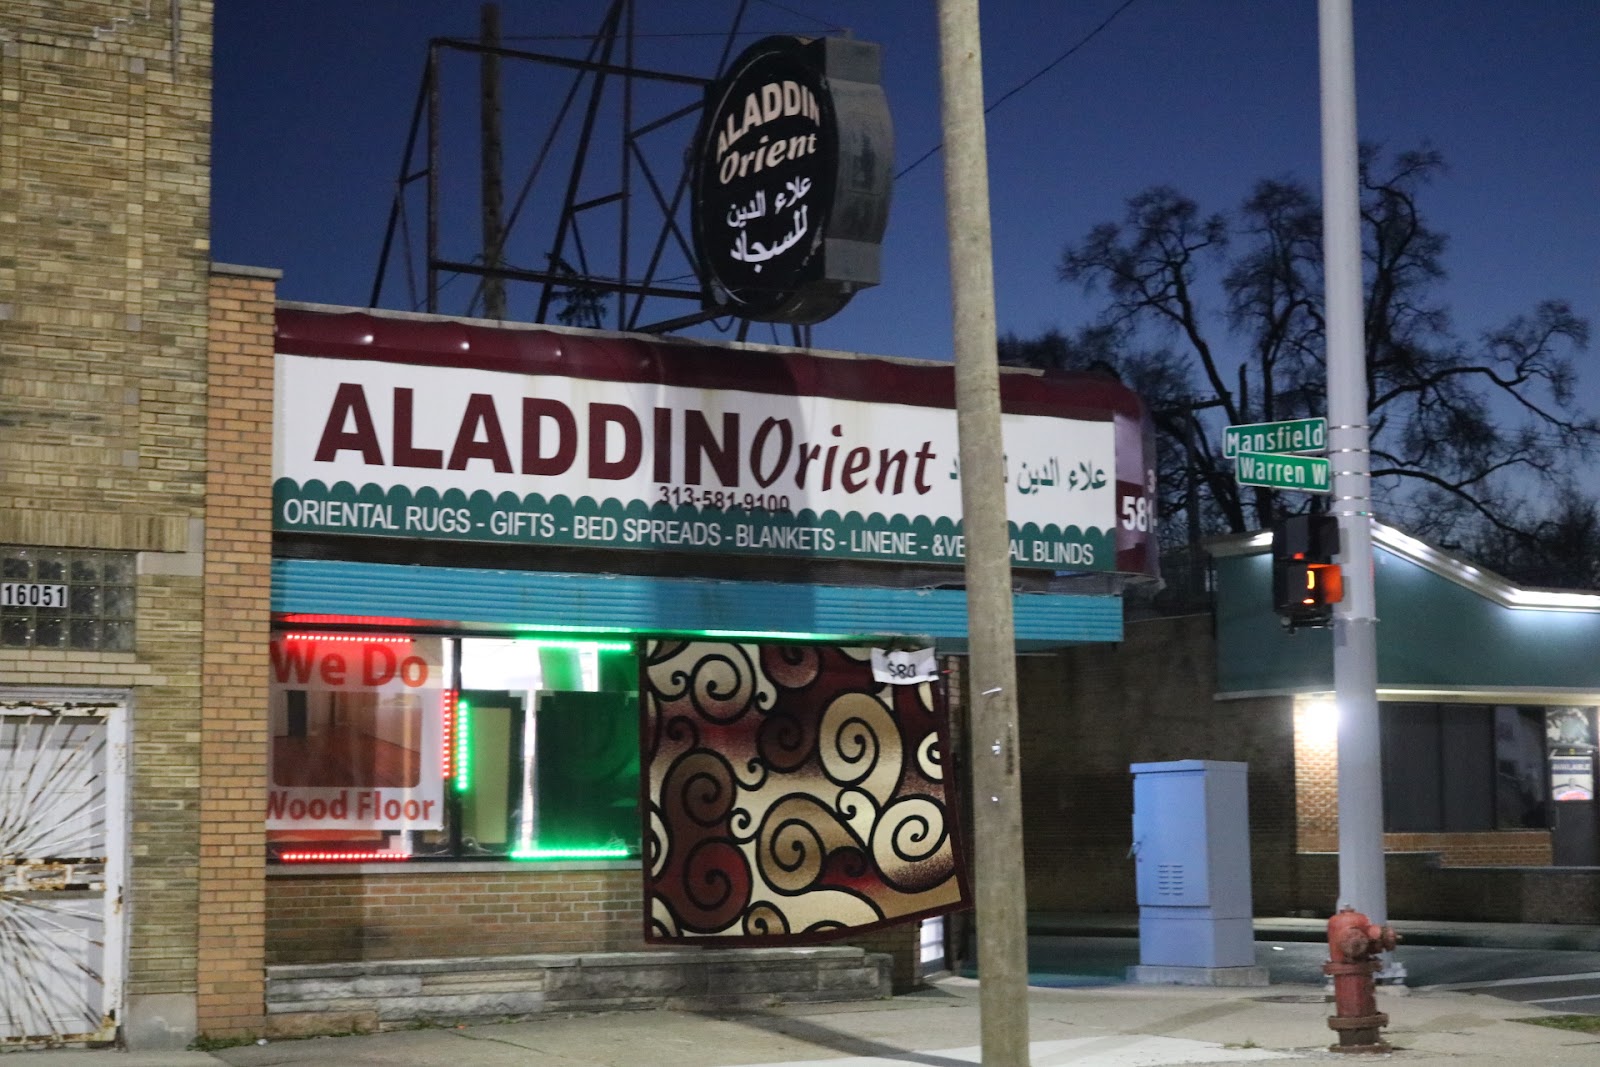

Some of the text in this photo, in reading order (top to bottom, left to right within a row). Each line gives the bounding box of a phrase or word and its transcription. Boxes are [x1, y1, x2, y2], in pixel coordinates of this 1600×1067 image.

[716, 79, 821, 164] ALADDIN
[719, 133, 818, 185] Orient
[726, 176, 812, 228] علاء الدين
[314, 381, 936, 496] ALADDIN Orient
[1226, 423, 1325, 454] Mansfield
[1016, 456, 1061, 495] الدين
[1068, 460, 1107, 491] علاء
[1239, 456, 1327, 486] Warren W
[659, 485, 790, 513] 313-581-9100
[283, 498, 400, 530] ORIENTAL
[405, 505, 471, 534] RUGS
[489, 510, 556, 538] GIFTS
[573, 515, 618, 542] BED
[622, 518, 722, 547] SPREADS
[735, 523, 836, 551] BLANKETS
[850, 530, 917, 556] LINENE
[1032, 540, 1094, 566] BLINDS
[5, 584, 64, 607] 16051
[270, 640, 429, 688] We Do
[266, 790, 435, 821] Wood Floor
